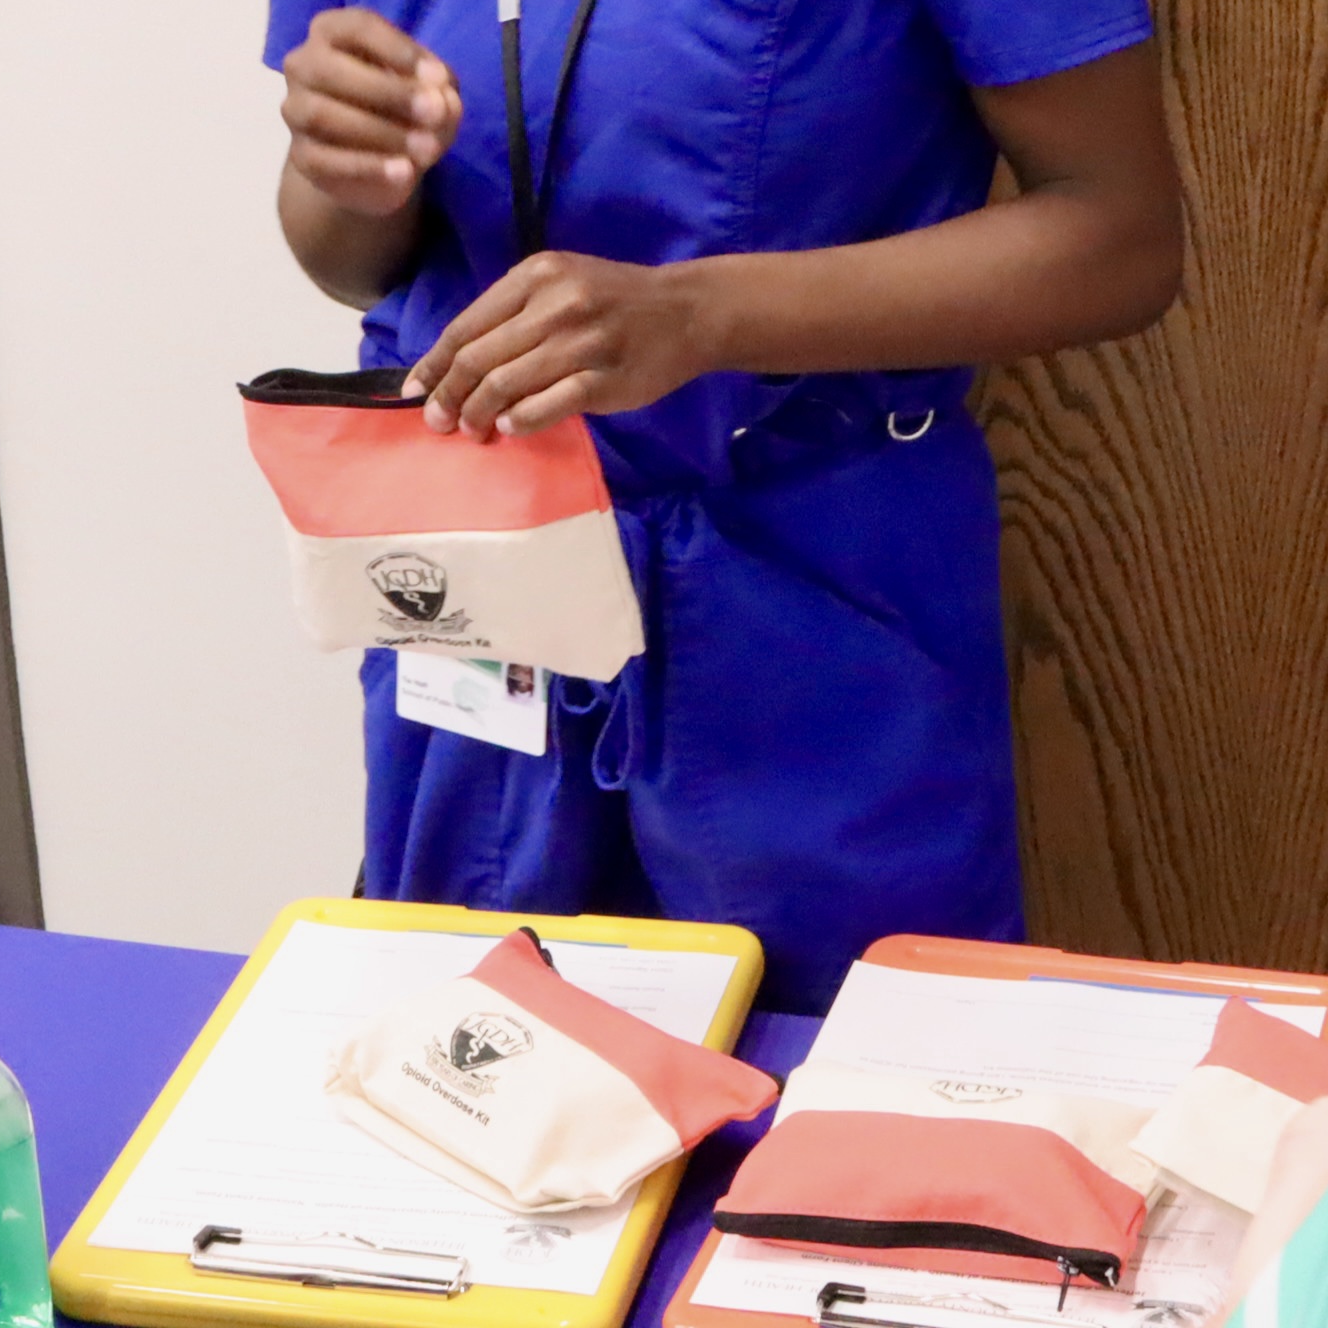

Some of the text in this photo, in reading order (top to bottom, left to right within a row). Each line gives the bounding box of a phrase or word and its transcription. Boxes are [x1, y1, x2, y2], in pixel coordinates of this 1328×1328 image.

[401, 1061, 491, 1126] Opioid Overdose Kit
